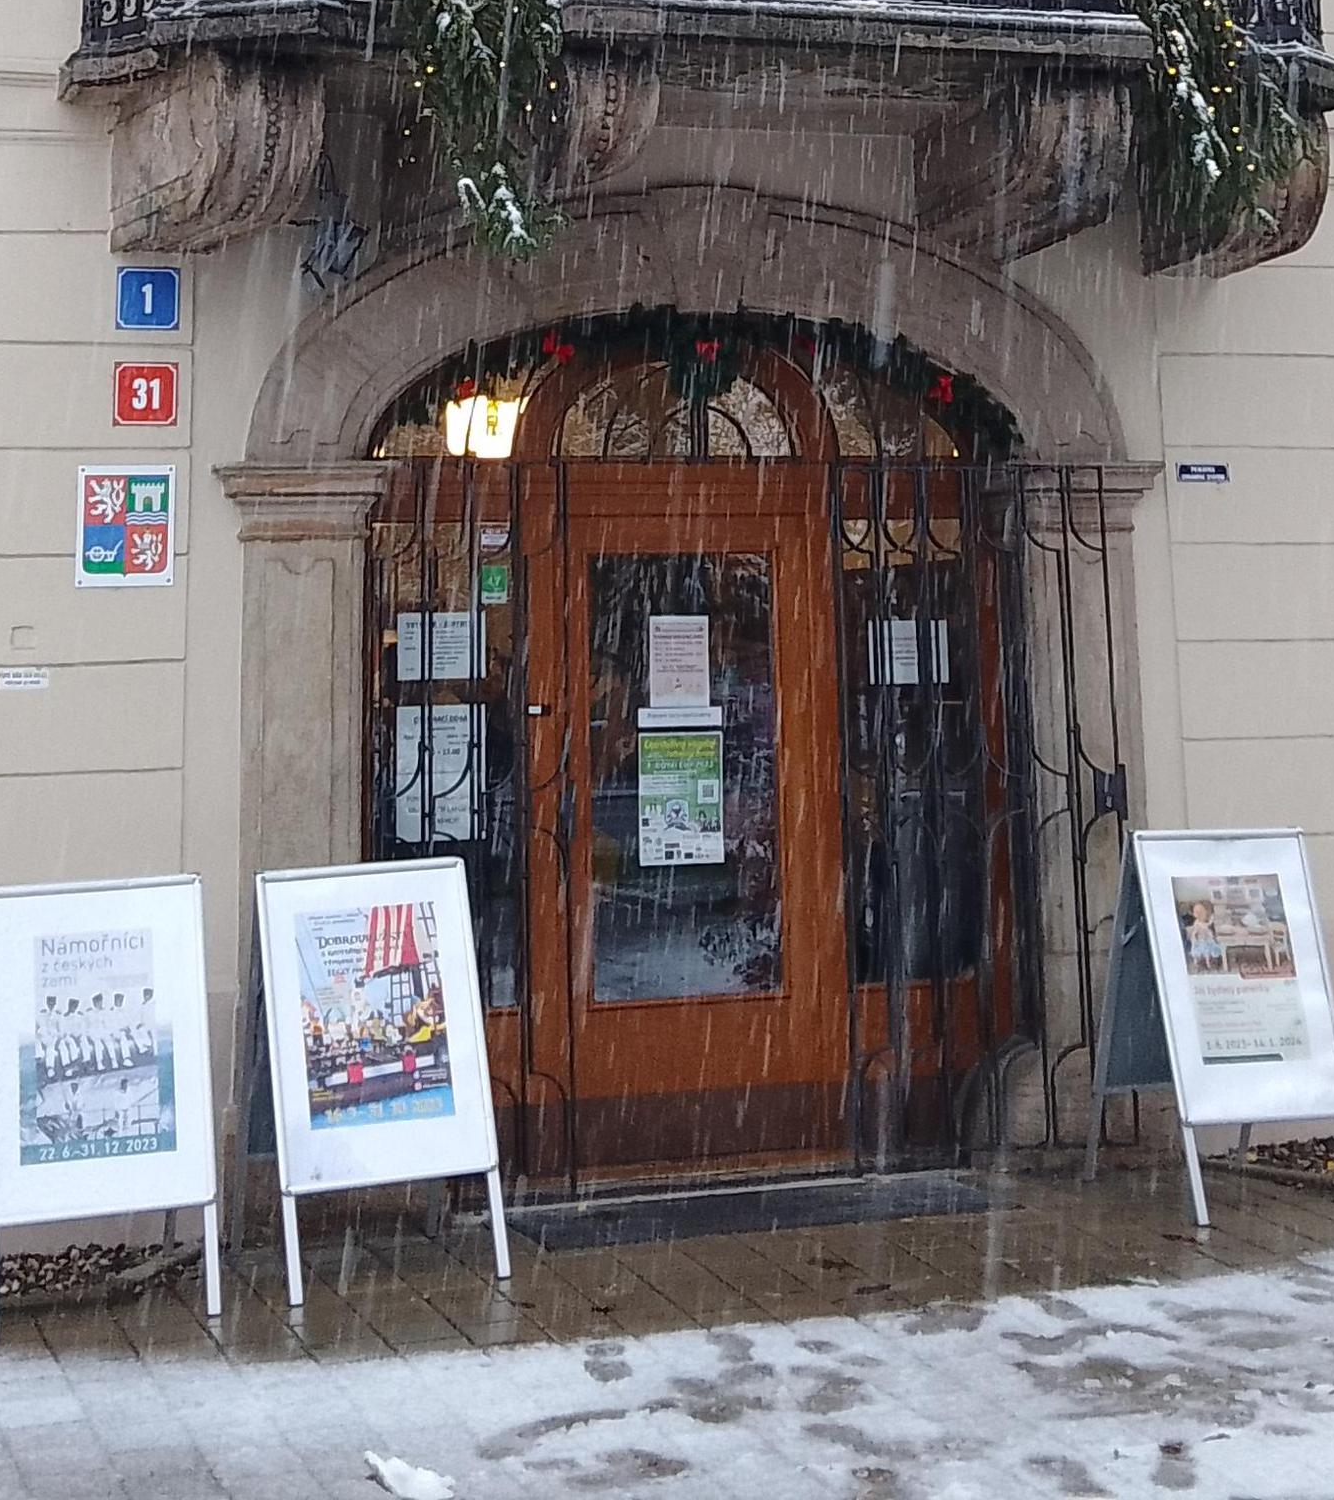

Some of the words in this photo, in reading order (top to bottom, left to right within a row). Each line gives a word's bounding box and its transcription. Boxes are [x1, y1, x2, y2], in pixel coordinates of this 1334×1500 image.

[141, 282, 153, 315] 1
[131, 377, 162, 411] 31
[41, 932, 145, 957] Námořníci
[126, 1137, 158, 1153] 2023
